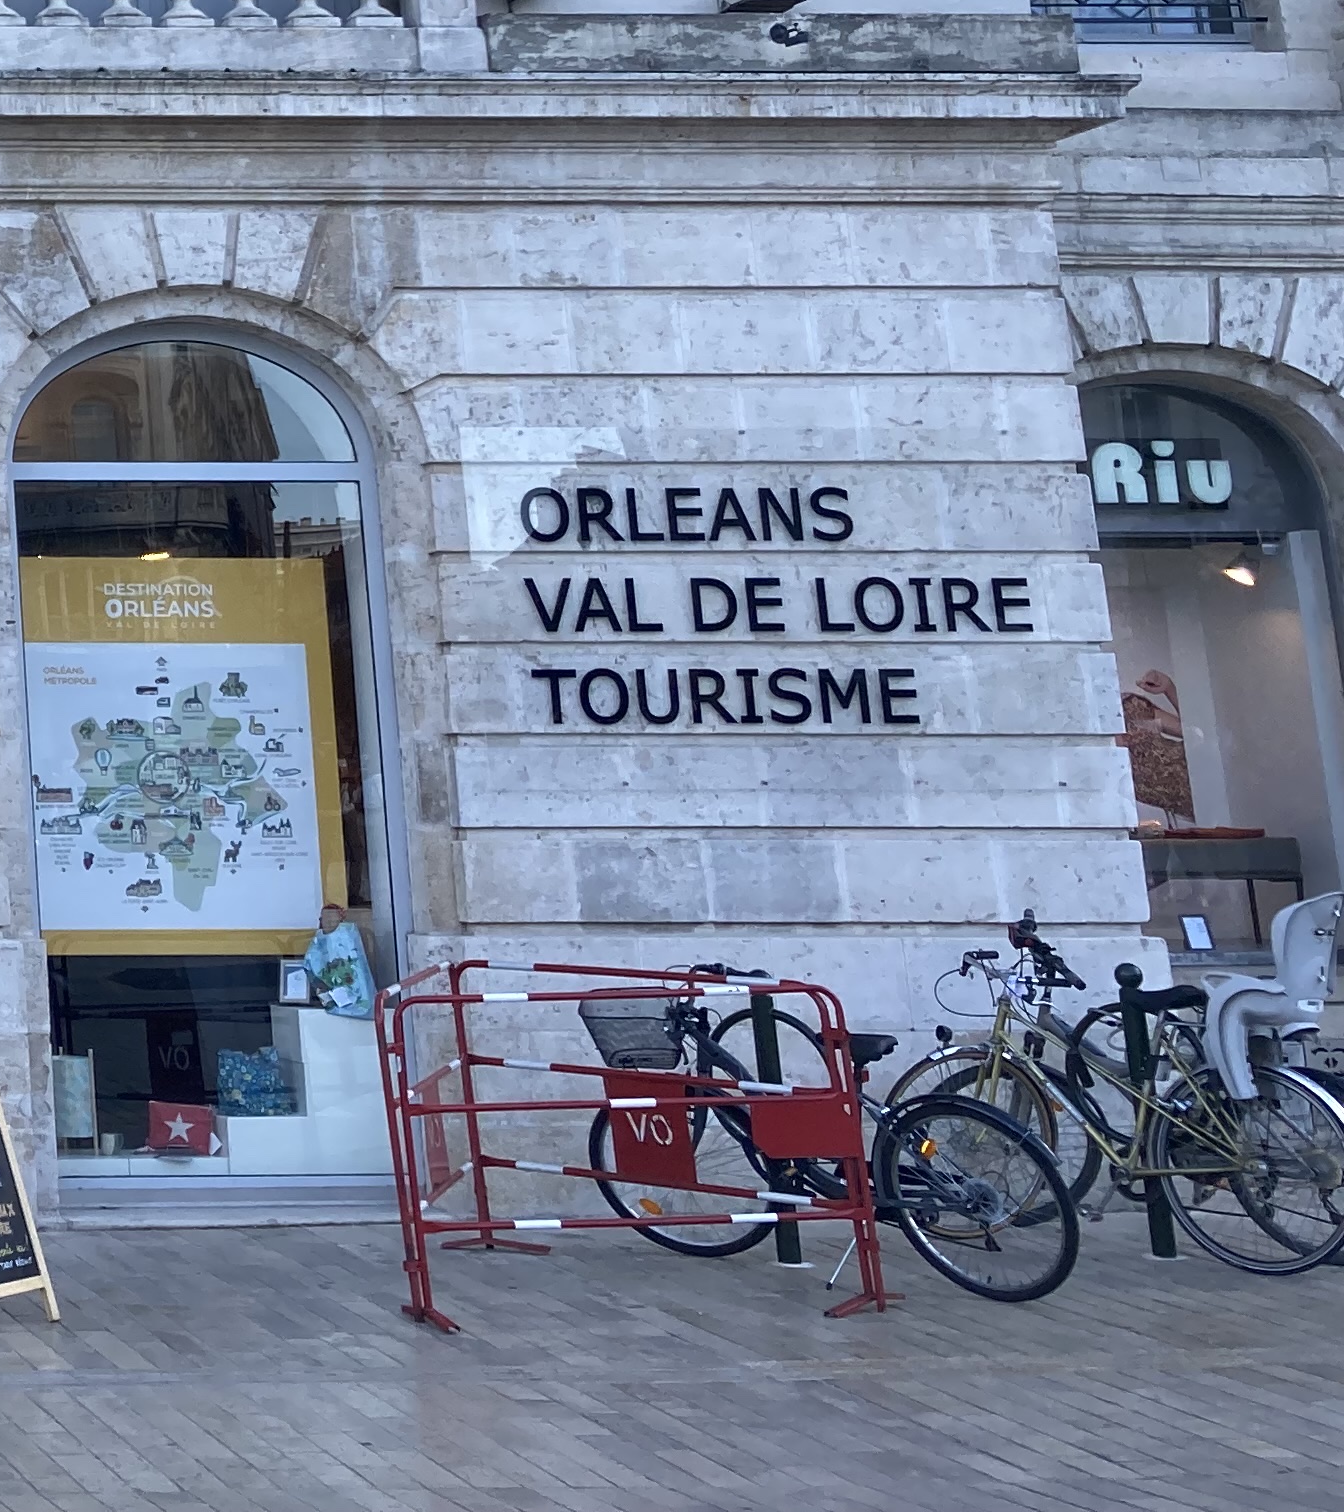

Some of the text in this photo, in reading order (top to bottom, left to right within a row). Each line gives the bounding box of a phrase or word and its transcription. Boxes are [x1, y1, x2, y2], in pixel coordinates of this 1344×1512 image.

[1091, 440, 1233, 504] Riu
[520, 486, 854, 543] ORLEANS
[103, 583, 213, 596] DESTINATION
[104, 596, 215, 619] ORLÉANS
[523, 576, 1035, 634] VAL DE LOIRE
[106, 621, 216, 629] VAL DE LOIRE
[531, 667, 921, 725] TOURISME
[624, 1111, 673, 1145] VO
